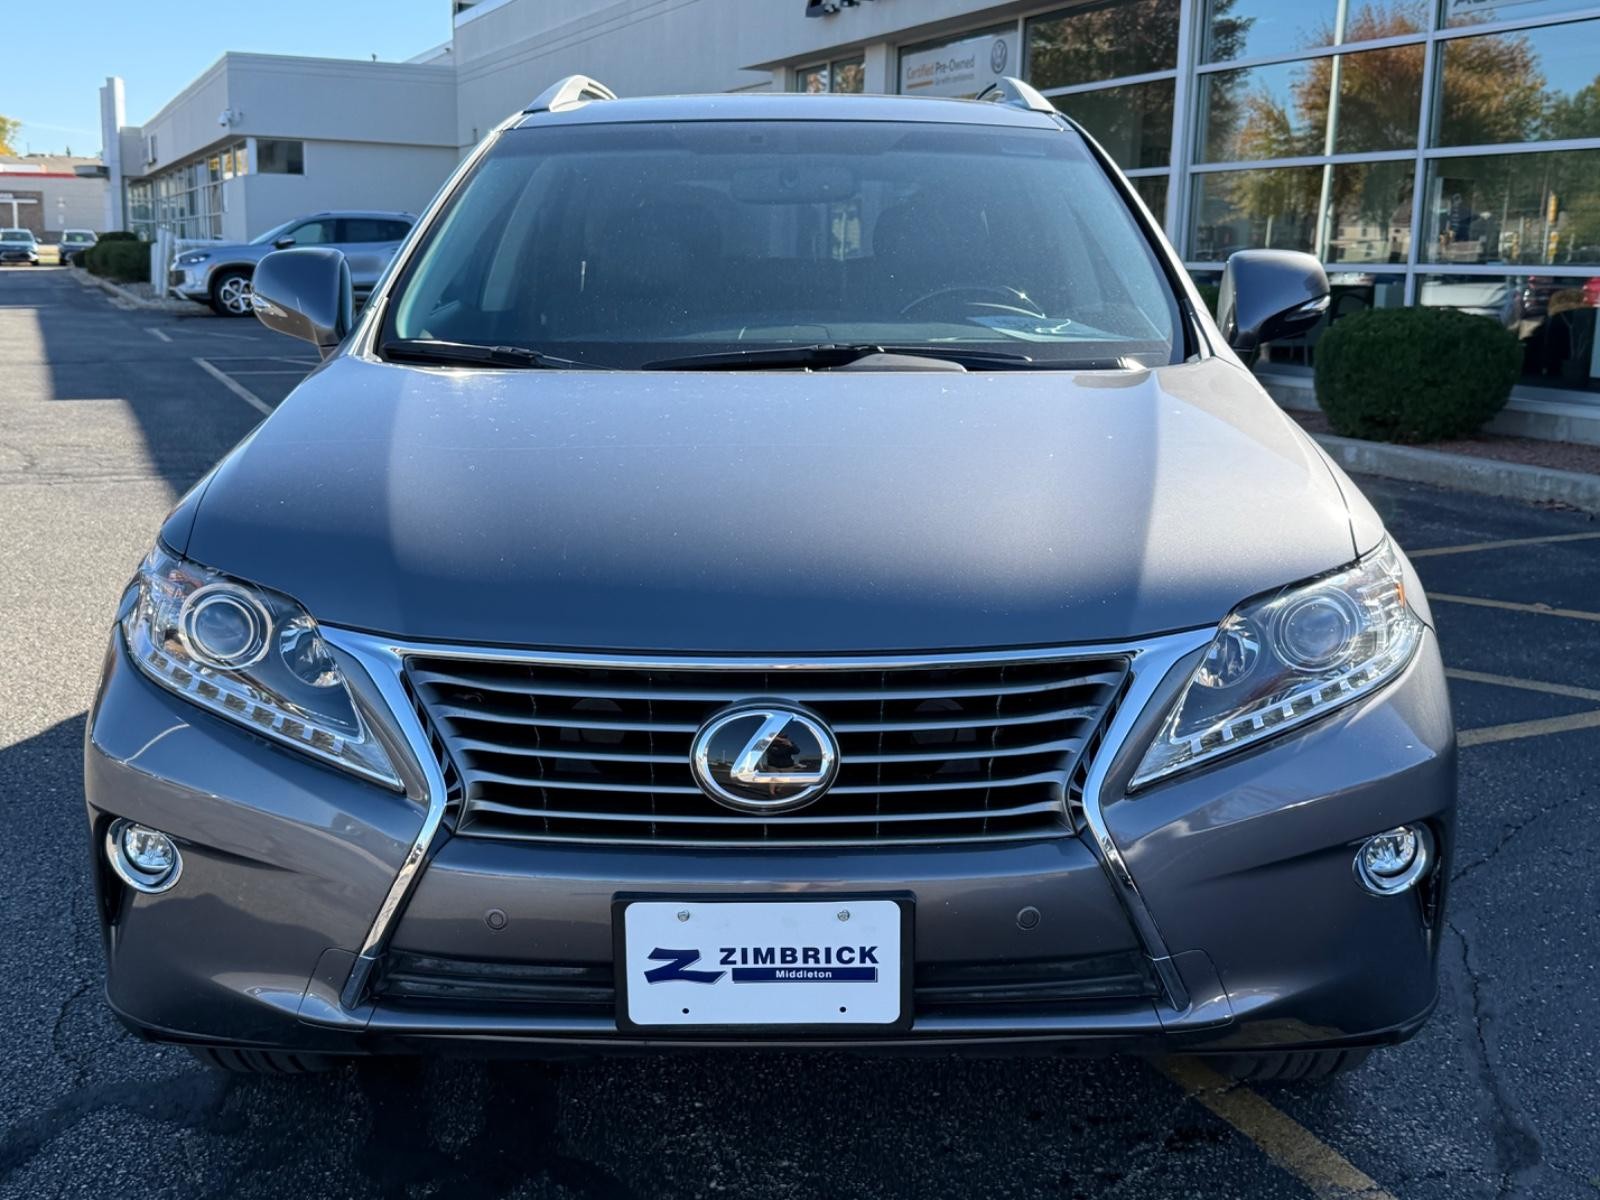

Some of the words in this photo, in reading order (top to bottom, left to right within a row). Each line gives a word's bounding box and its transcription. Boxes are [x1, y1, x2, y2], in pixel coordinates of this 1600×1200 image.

[935, 55, 975, 74] Pre-Owned
[719, 946, 879, 965] ZIMBRICK
[775, 969, 832, 979] Middleton
